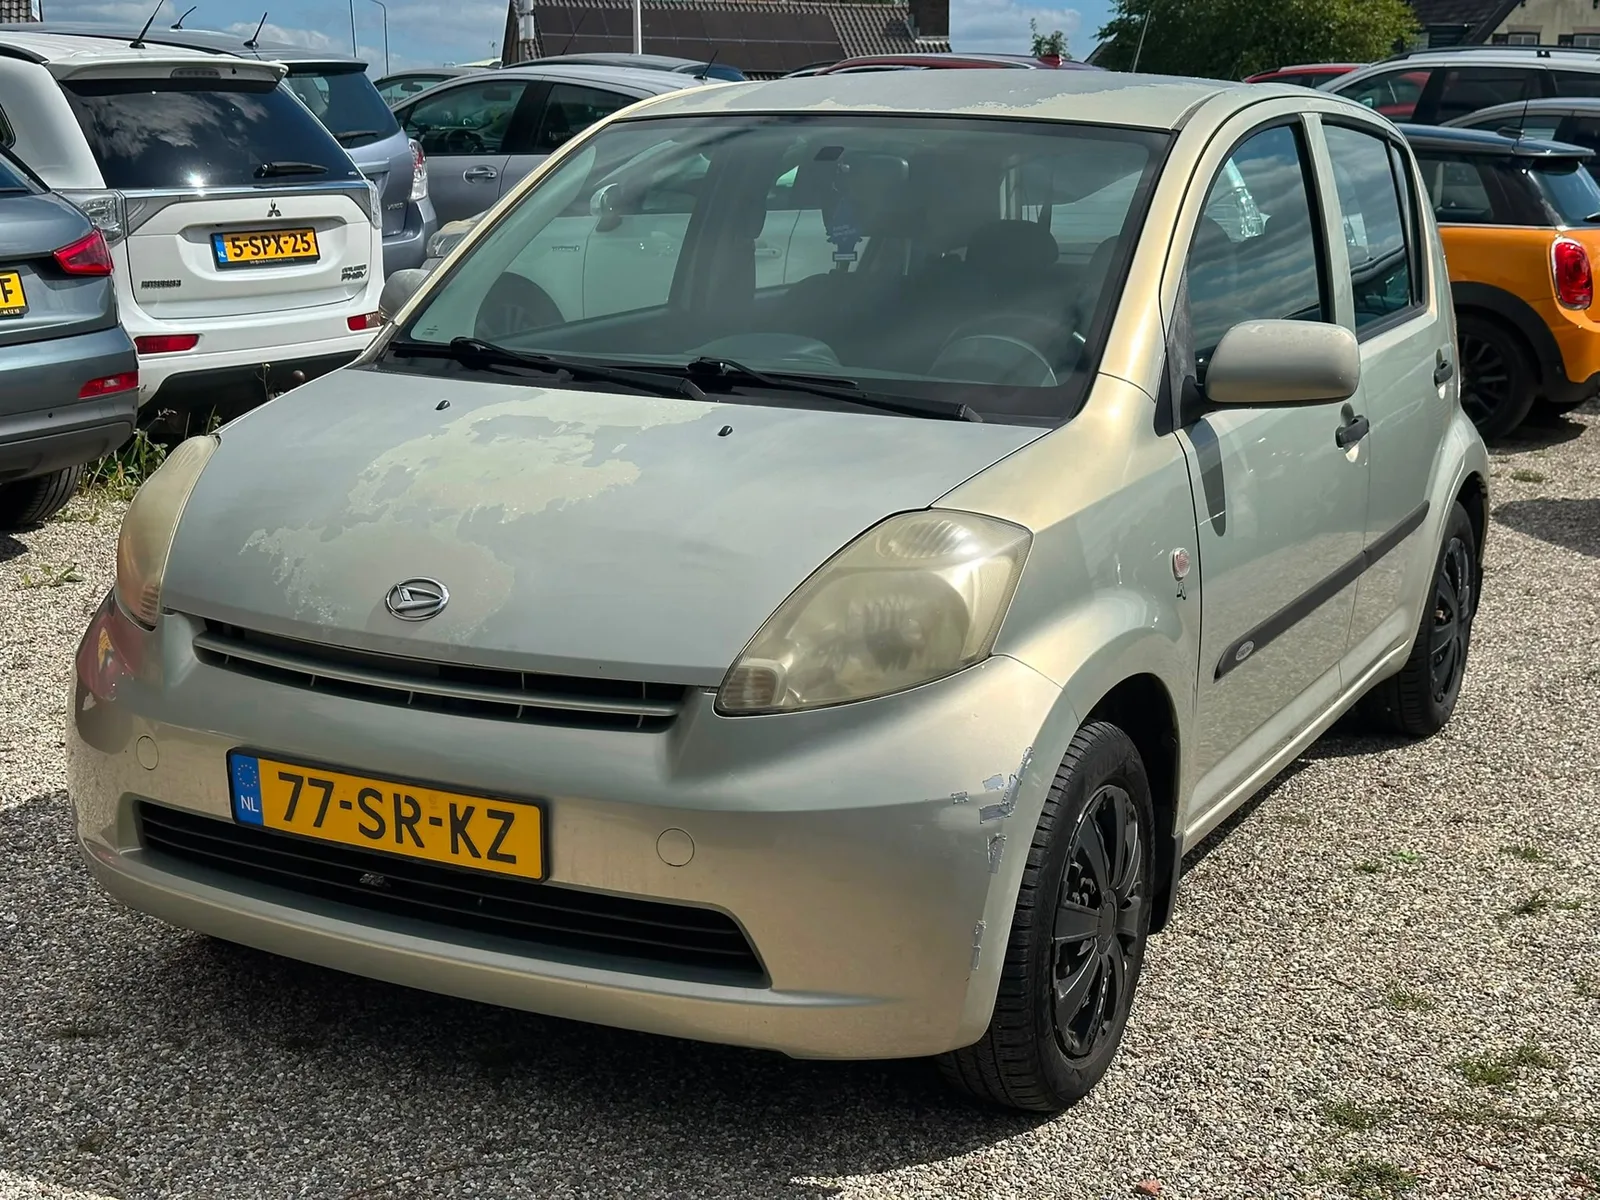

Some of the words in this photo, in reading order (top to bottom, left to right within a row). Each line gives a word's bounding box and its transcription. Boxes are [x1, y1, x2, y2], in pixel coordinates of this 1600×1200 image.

[230, 232, 311, 258] 5-SPX-25
[240, 794, 259, 813] NL
[278, 771, 517, 865] 77-SR-KZ
